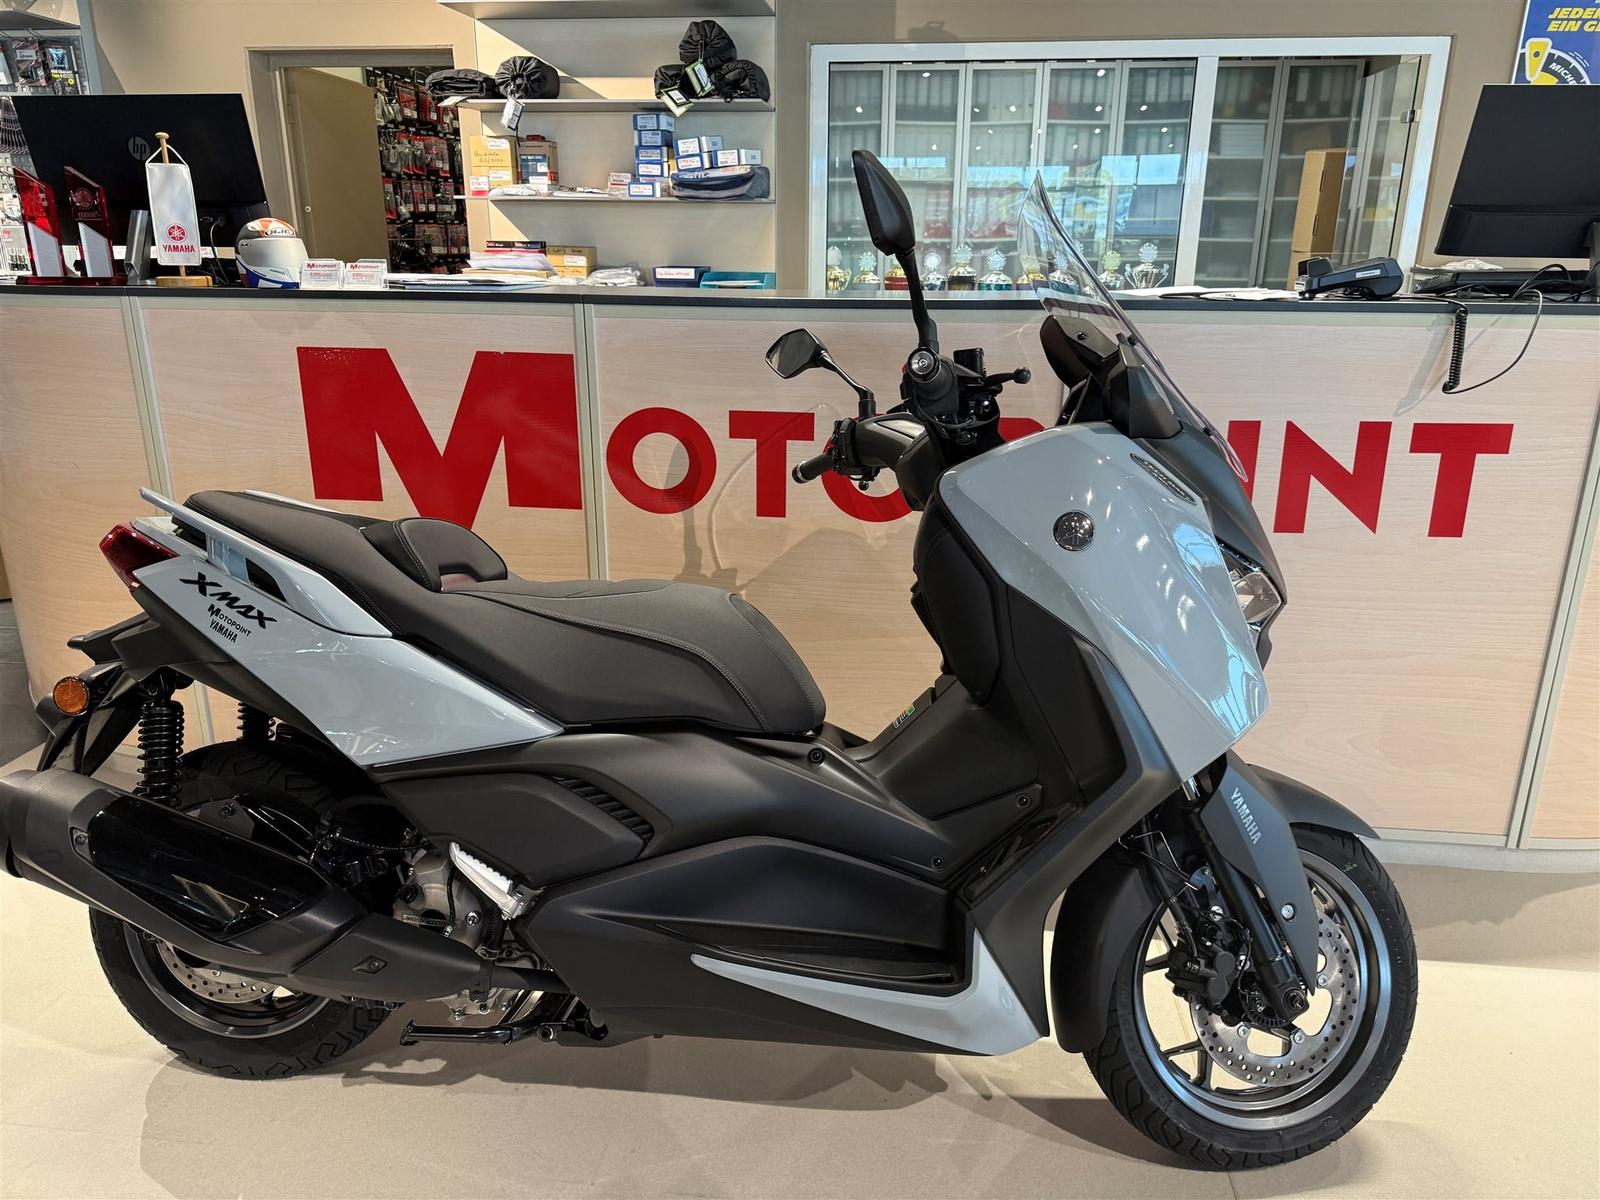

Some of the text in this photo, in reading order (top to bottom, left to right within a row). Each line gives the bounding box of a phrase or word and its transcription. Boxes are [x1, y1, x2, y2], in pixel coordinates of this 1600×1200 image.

[1547, 20, 1583, 32] EIN
[162, 244, 195, 253] YAMAHA
[207, 603, 252, 637] MOTOPOINT
[209, 619, 238, 643] YAMAHA
[1230, 787, 1262, 845] YAMAHA
